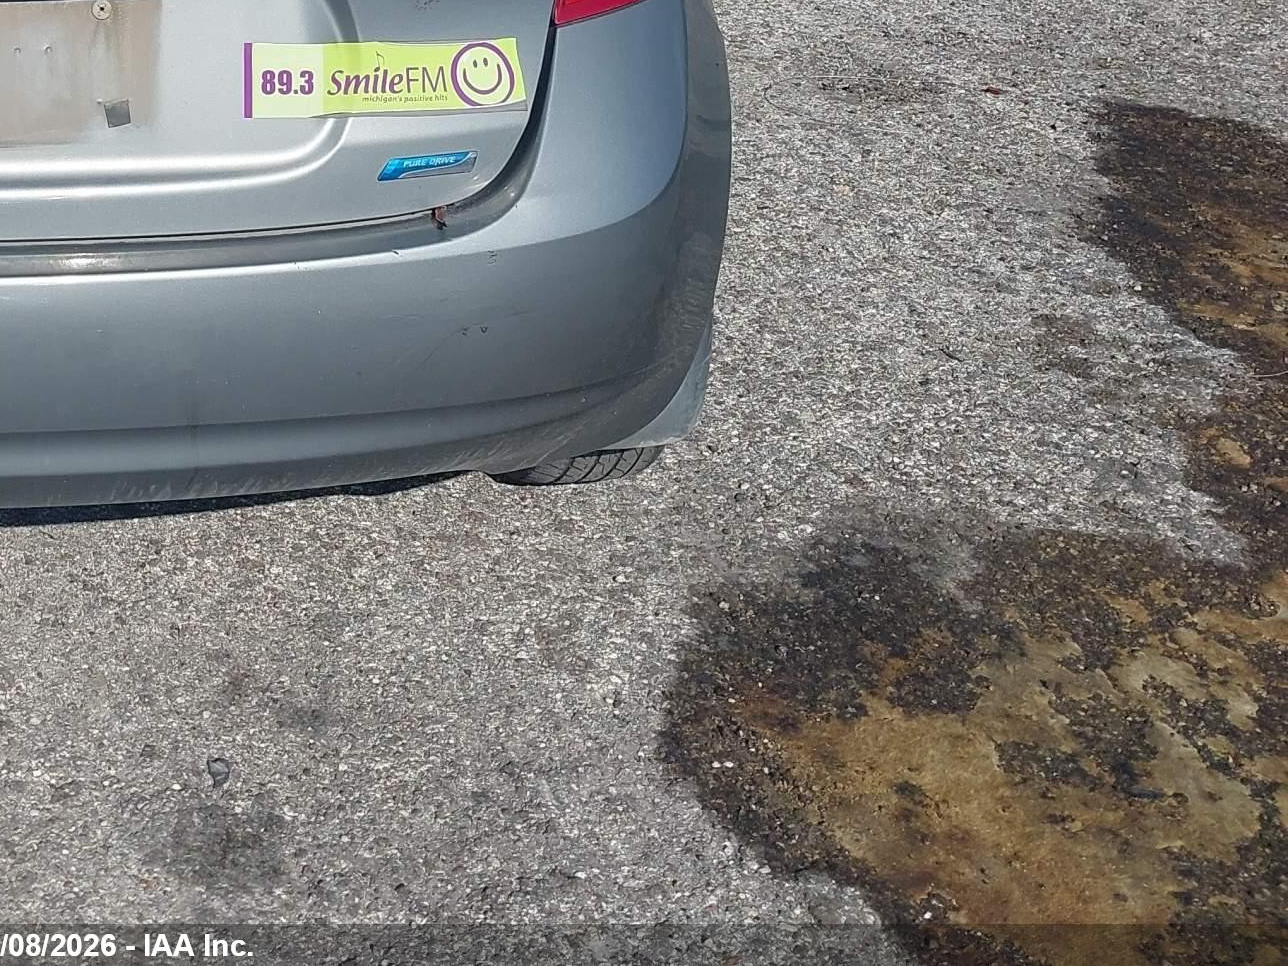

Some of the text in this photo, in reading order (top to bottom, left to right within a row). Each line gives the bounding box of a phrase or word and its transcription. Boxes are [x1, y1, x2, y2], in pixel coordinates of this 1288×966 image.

[261, 69, 314, 95] 89.3
[404, 94, 433, 103] positive
[403, 156, 456, 168] PURE DRIVE
